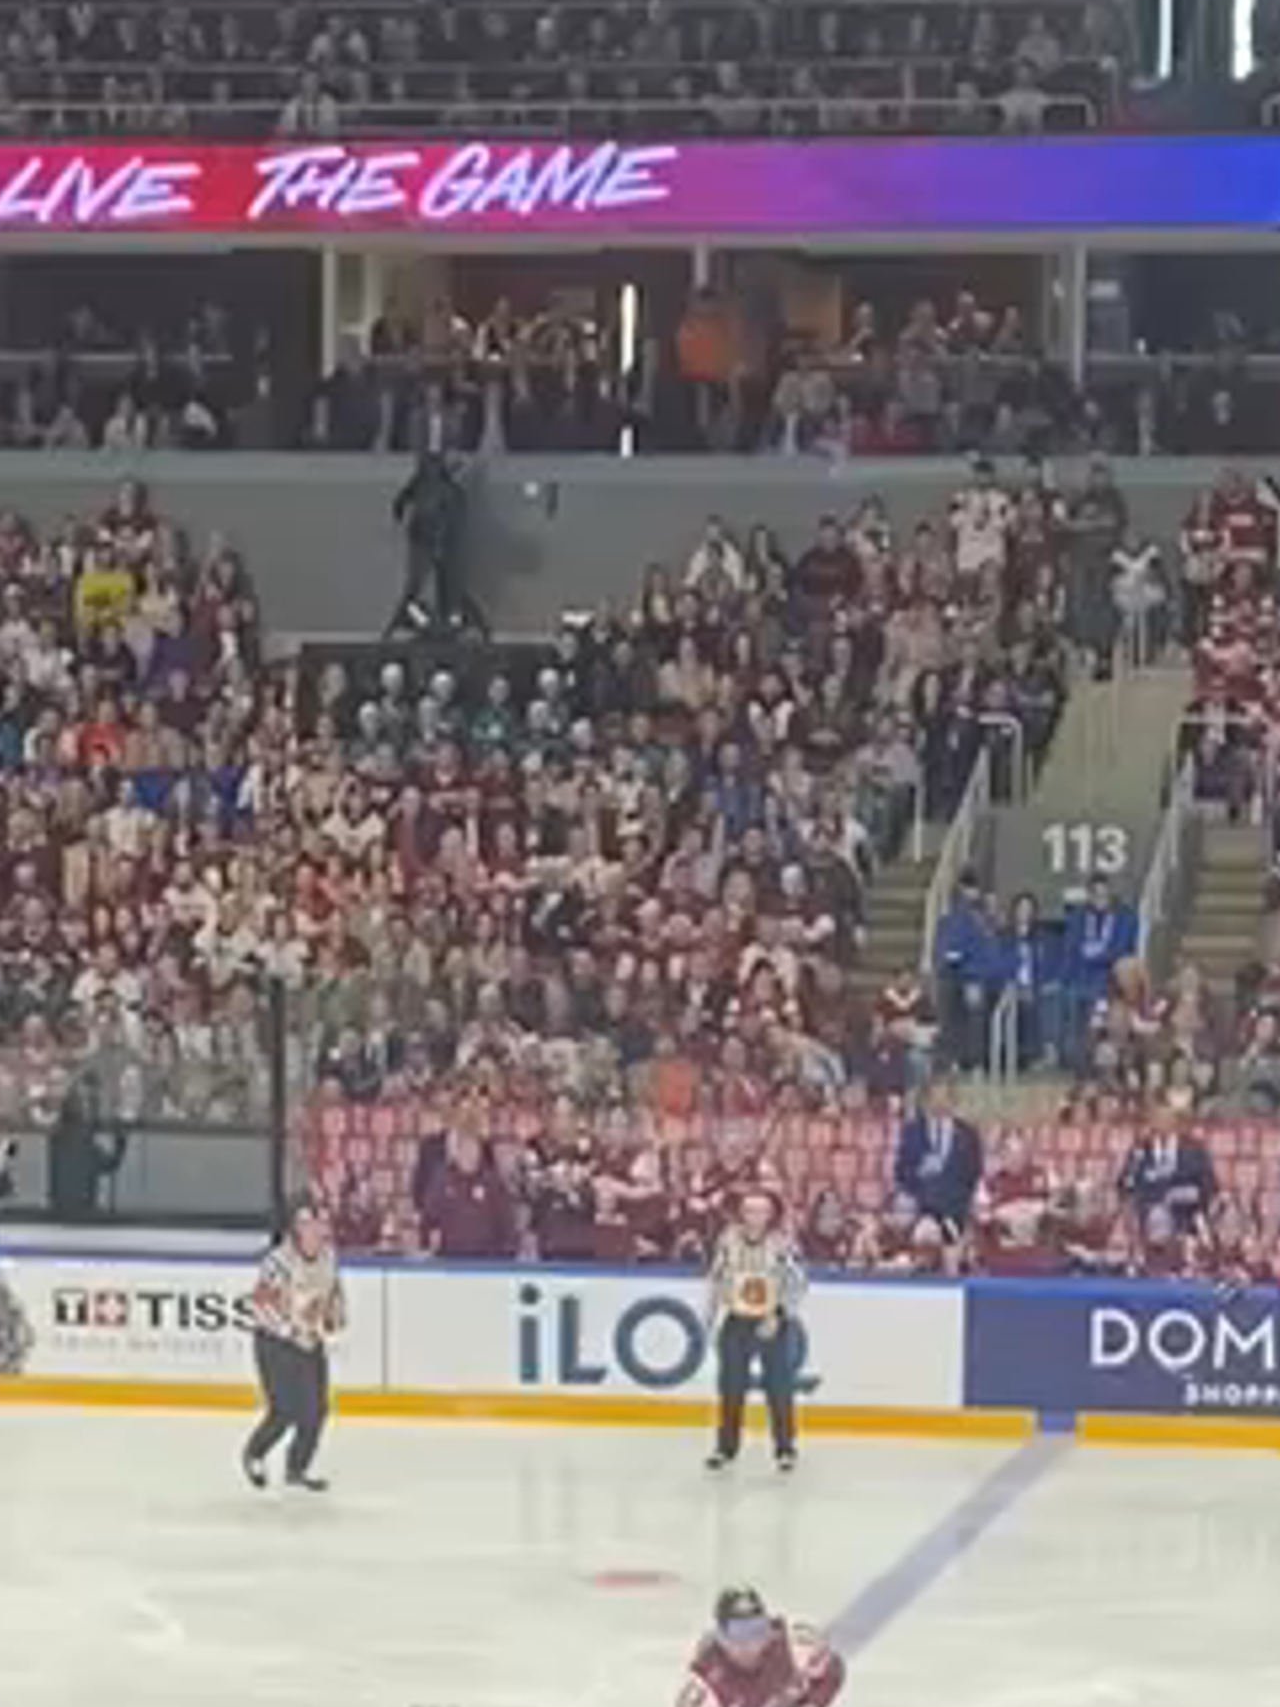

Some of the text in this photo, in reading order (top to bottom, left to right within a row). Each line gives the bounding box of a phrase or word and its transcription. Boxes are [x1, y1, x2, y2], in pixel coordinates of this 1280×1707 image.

[247, 146, 420, 220] THE
[419, 140, 678, 219] GAME
[1042, 822, 1129, 874] 113
[135, 1290, 258, 1332] TISS
[517, 1282, 822, 1394] iLO
